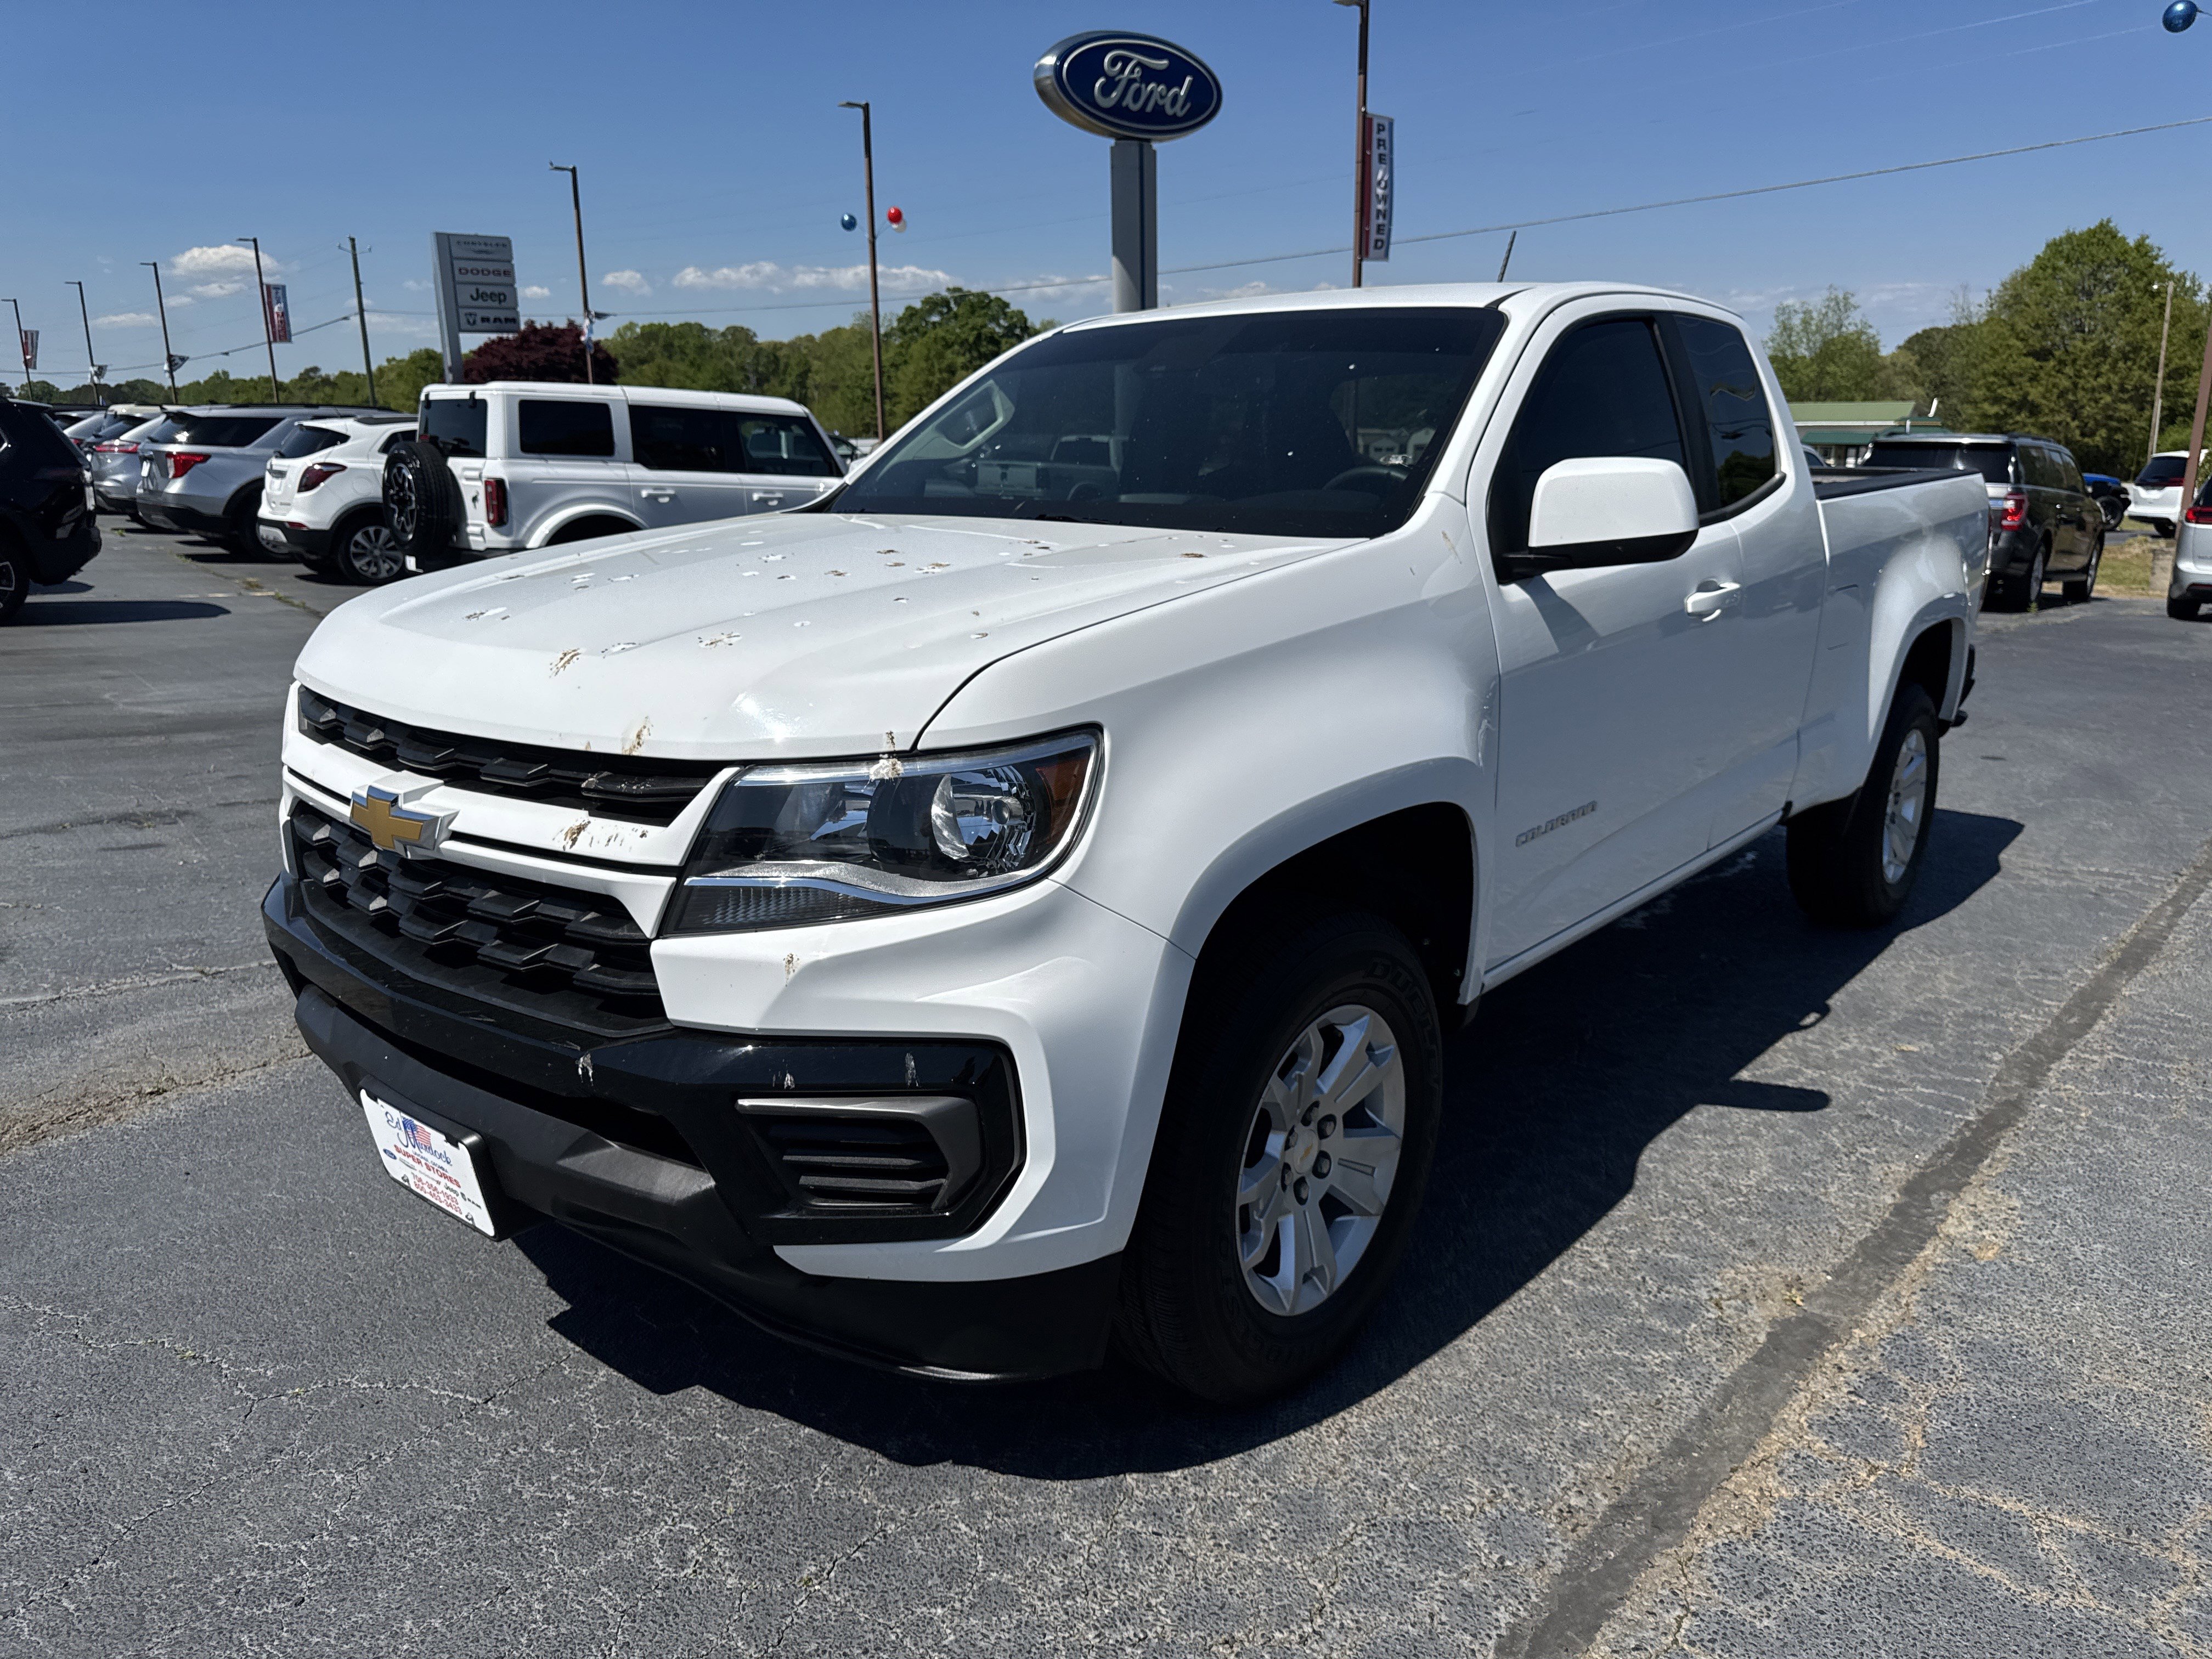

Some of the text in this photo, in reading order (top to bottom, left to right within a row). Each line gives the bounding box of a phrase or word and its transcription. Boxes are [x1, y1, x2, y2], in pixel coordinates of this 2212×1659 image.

[1094, 49, 1193, 117] Ford
[1376, 122, 1387, 165] PRE
[458, 267, 512, 278] DODGE
[470, 288, 507, 304] Jeep
[481, 315, 517, 324] RAM
[1515, 800, 1598, 848] COLORADO
[385, 1111, 403, 1132] Ed
[394, 1144, 423, 1167] SUPER
[425, 1162, 461, 1189] STORES
